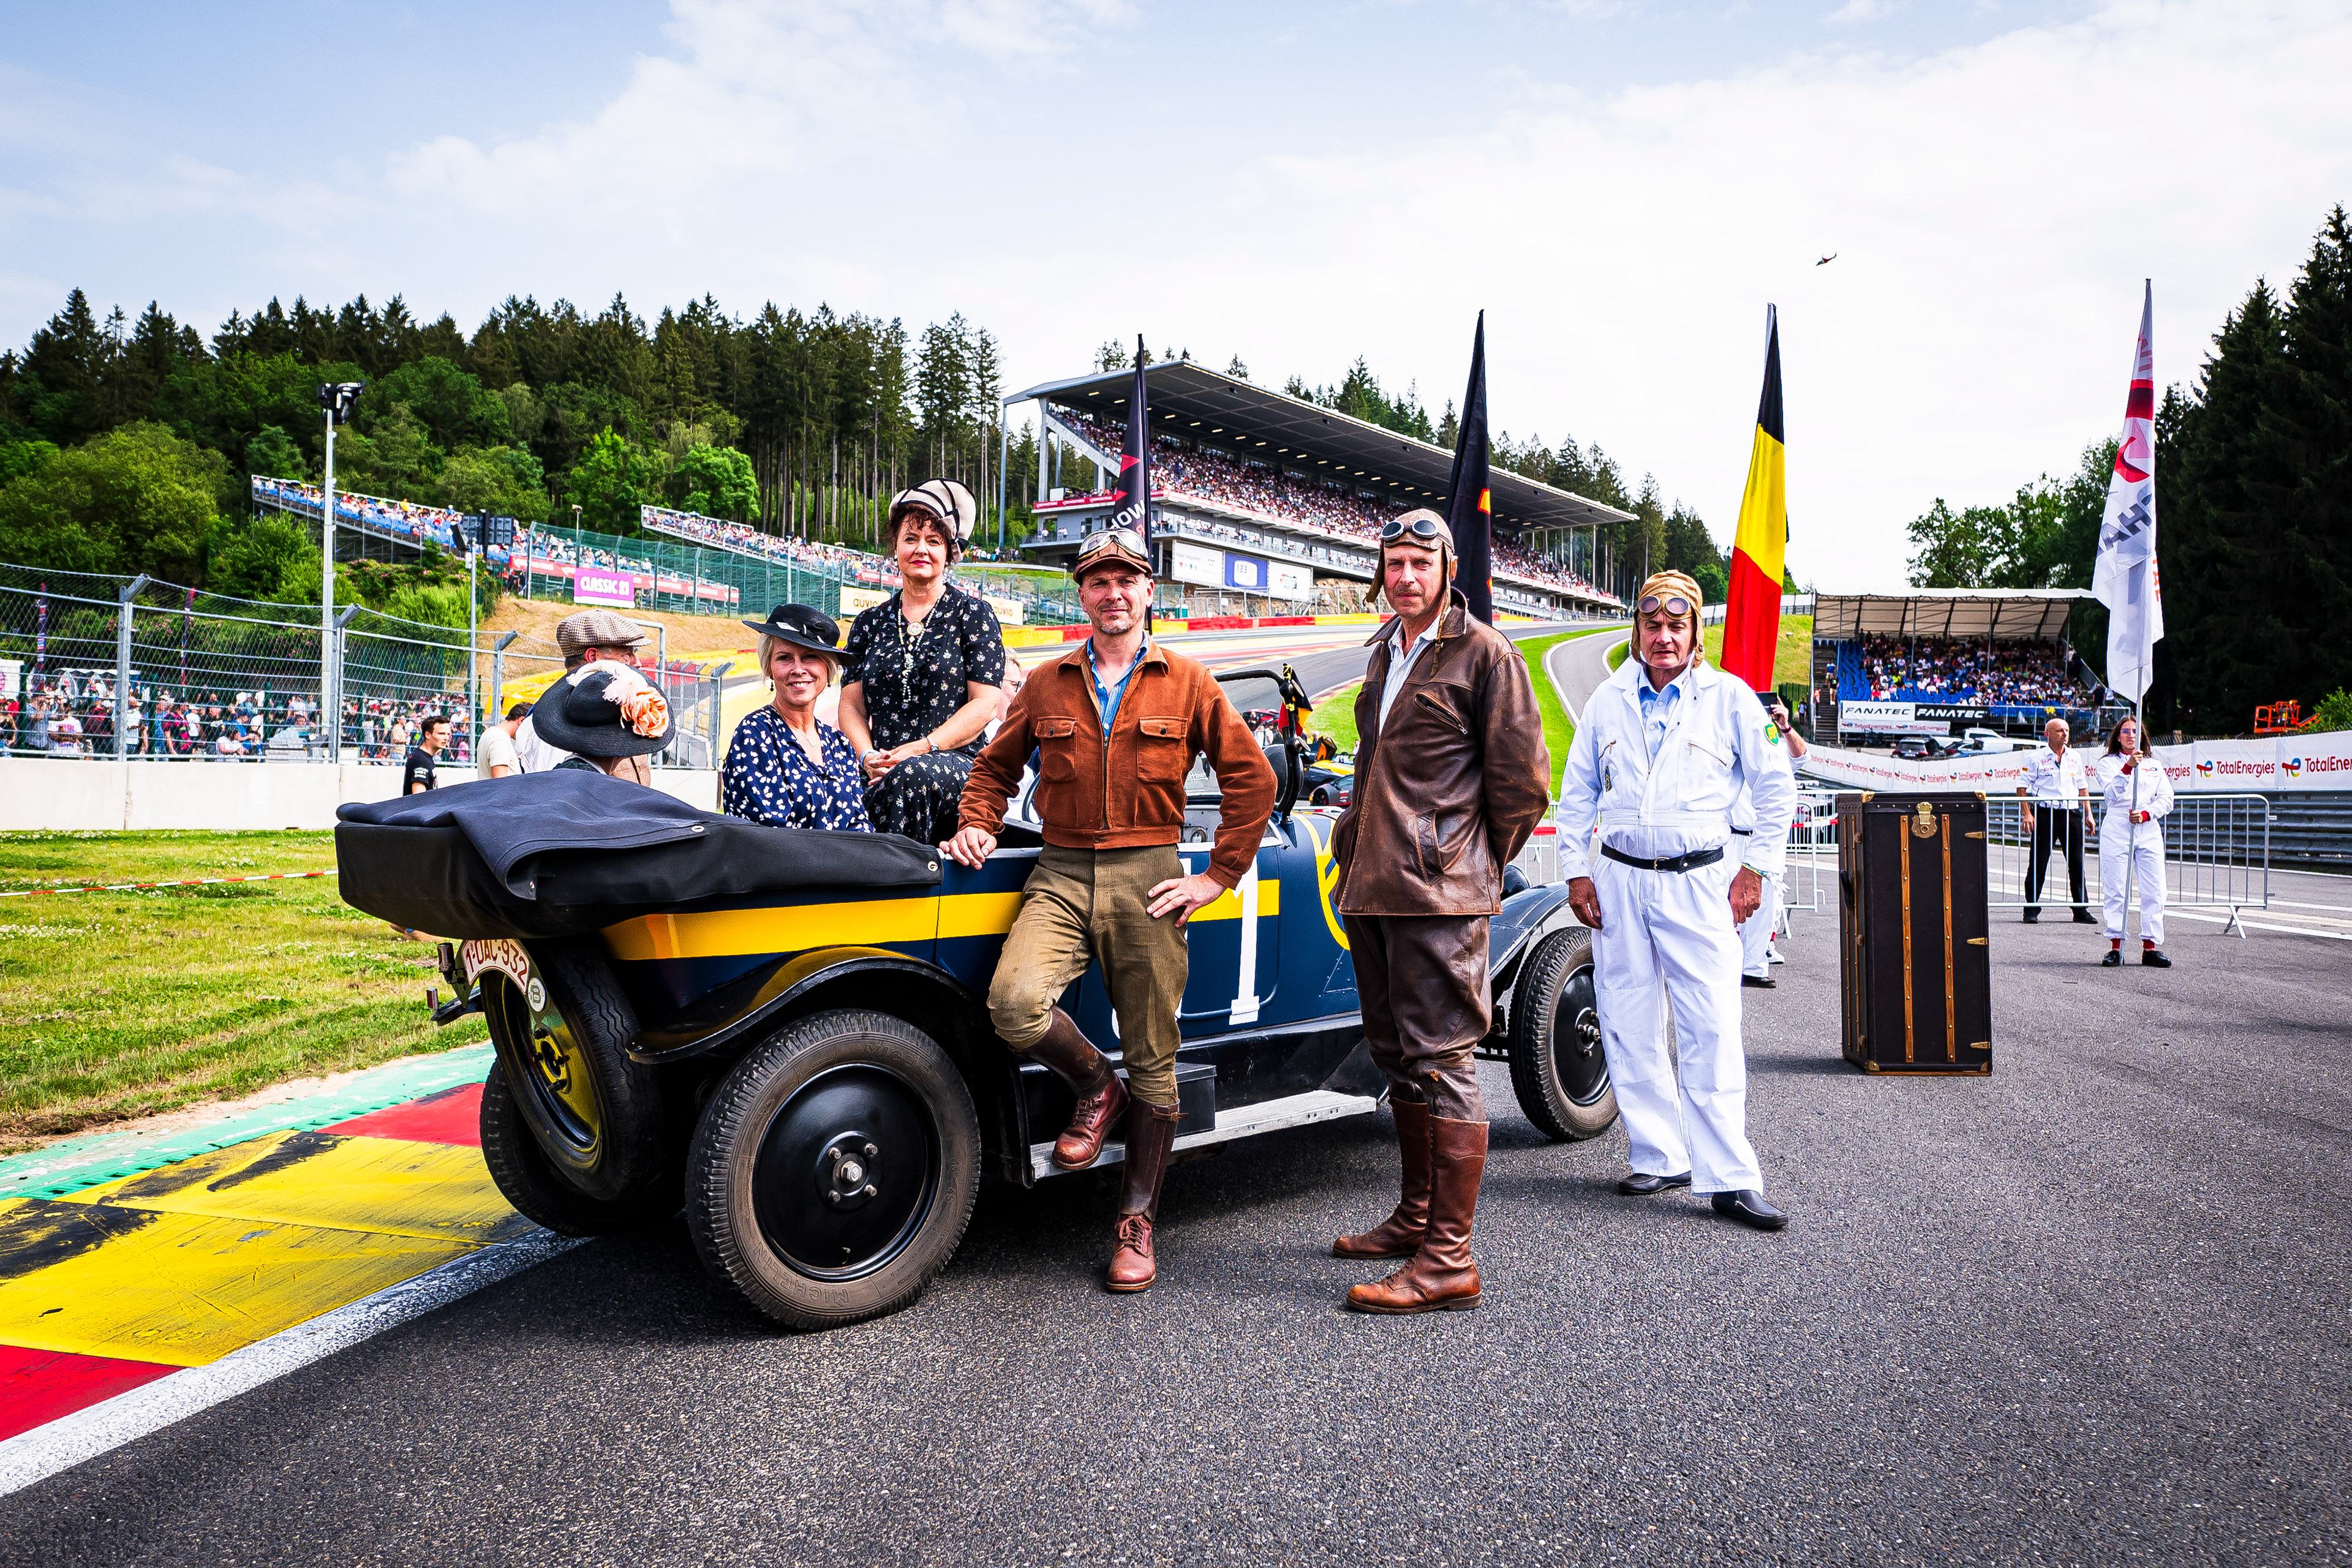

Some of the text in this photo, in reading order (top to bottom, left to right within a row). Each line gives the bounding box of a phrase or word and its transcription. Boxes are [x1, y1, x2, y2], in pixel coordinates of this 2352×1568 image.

[580, 576, 618, 594] CLASSIC
[618, 579, 630, 596] 21
[1845, 707, 1911, 715] FANATEC
[1917, 708, 1985, 718] FANATEC
[2217, 760, 2275, 778] TotalEnergies
[530, 985, 540, 1004] B
[753, 1242, 849, 1303] MICHELIN
